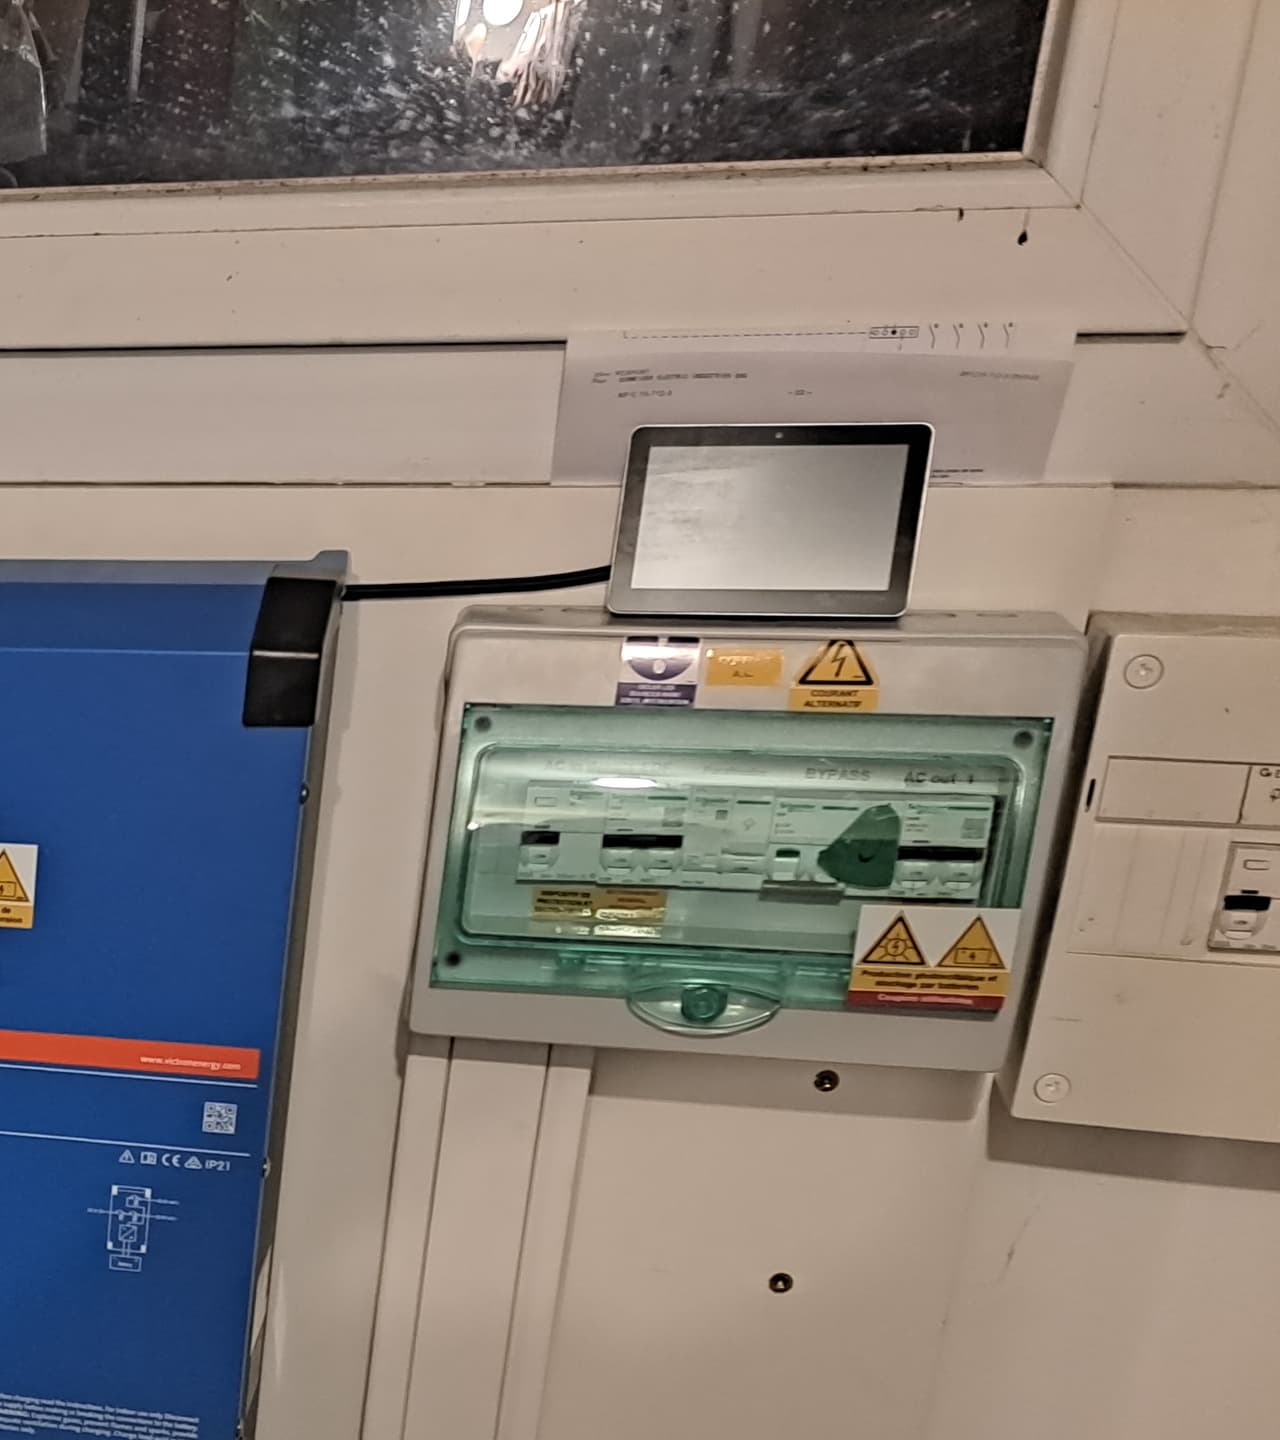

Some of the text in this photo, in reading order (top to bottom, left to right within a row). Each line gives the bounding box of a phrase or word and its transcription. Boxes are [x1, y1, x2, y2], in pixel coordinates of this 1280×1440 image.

[810, 689, 859, 698] COURANT
[805, 767, 871, 781] BYPASS
[904, 770, 926, 784] AC
[931, 773, 957, 785] out
[140, 1056, 241, 1071] www.victronenergy.com
[205, 1159, 230, 1171] IP21
